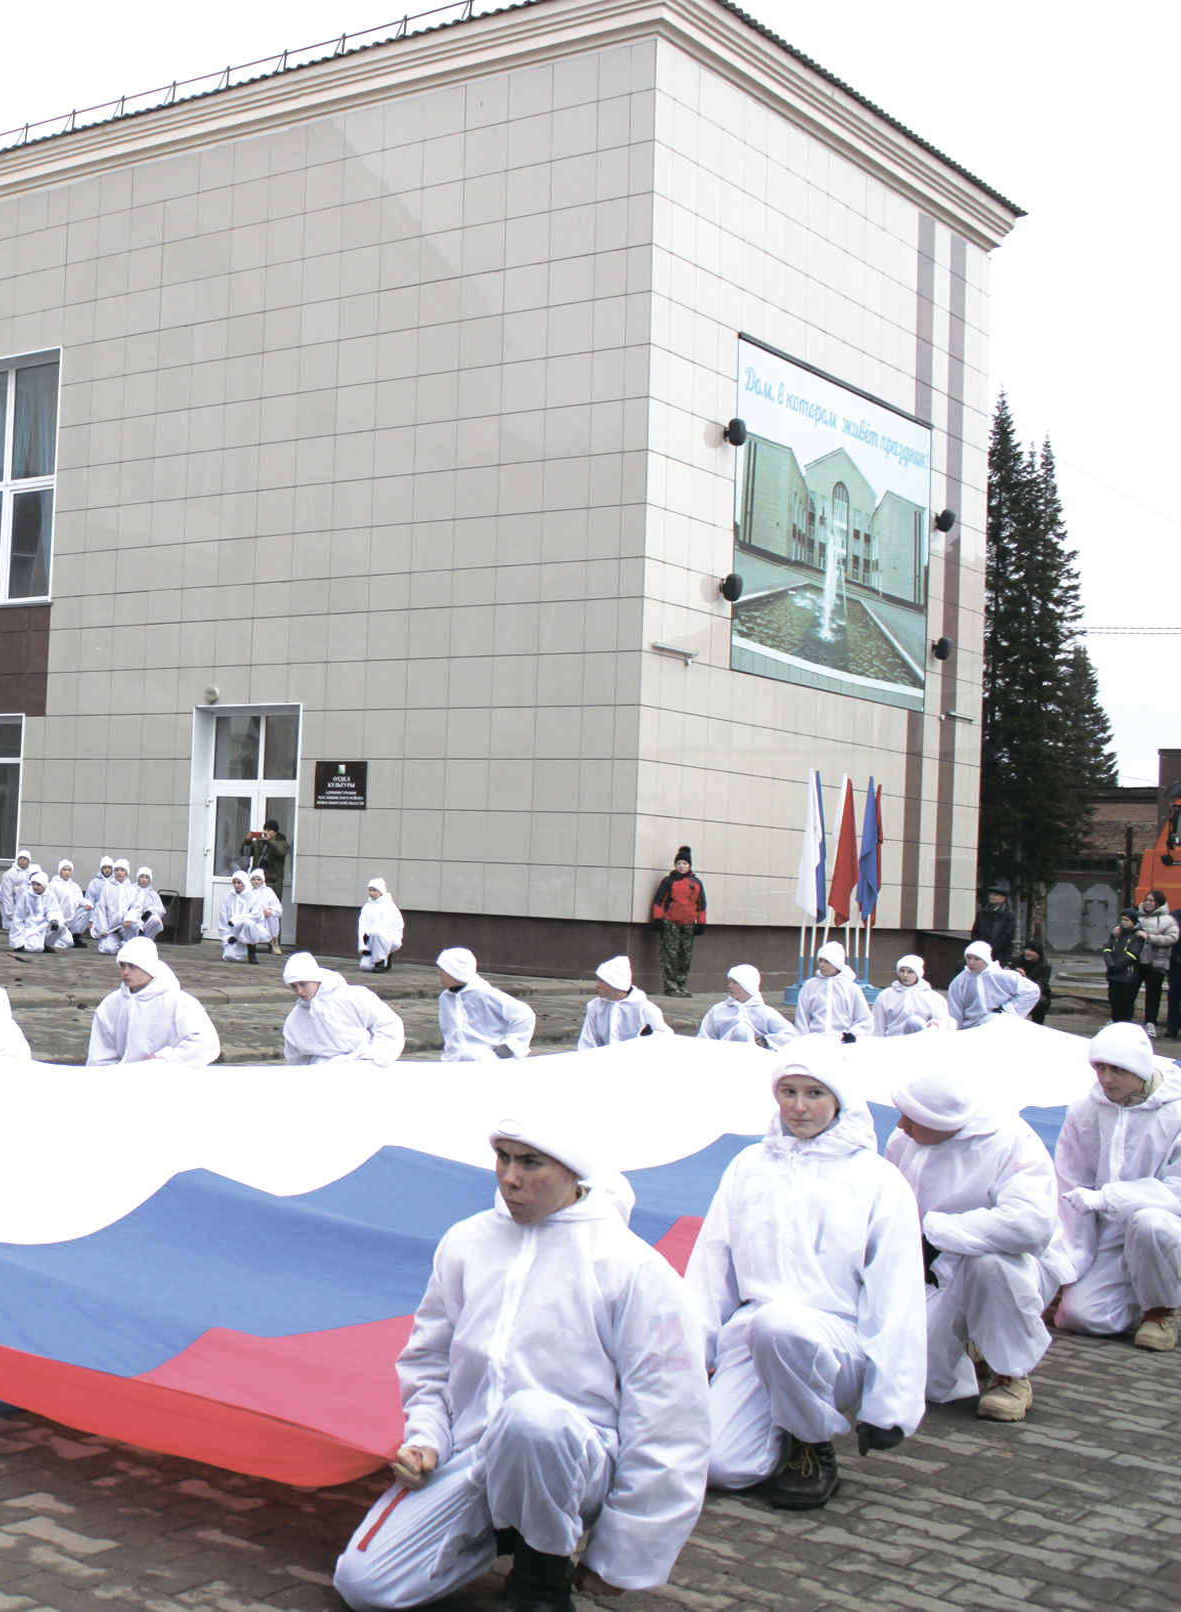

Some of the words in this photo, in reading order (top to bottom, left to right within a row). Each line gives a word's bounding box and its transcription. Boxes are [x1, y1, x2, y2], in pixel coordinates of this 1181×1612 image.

[744, 366, 775, 404] Дом,
[777, 381, 785, 405] в
[785, 392, 837, 429] котором
[841, 419, 879, 448] живёт
[879, 435, 929, 470] праздник!
